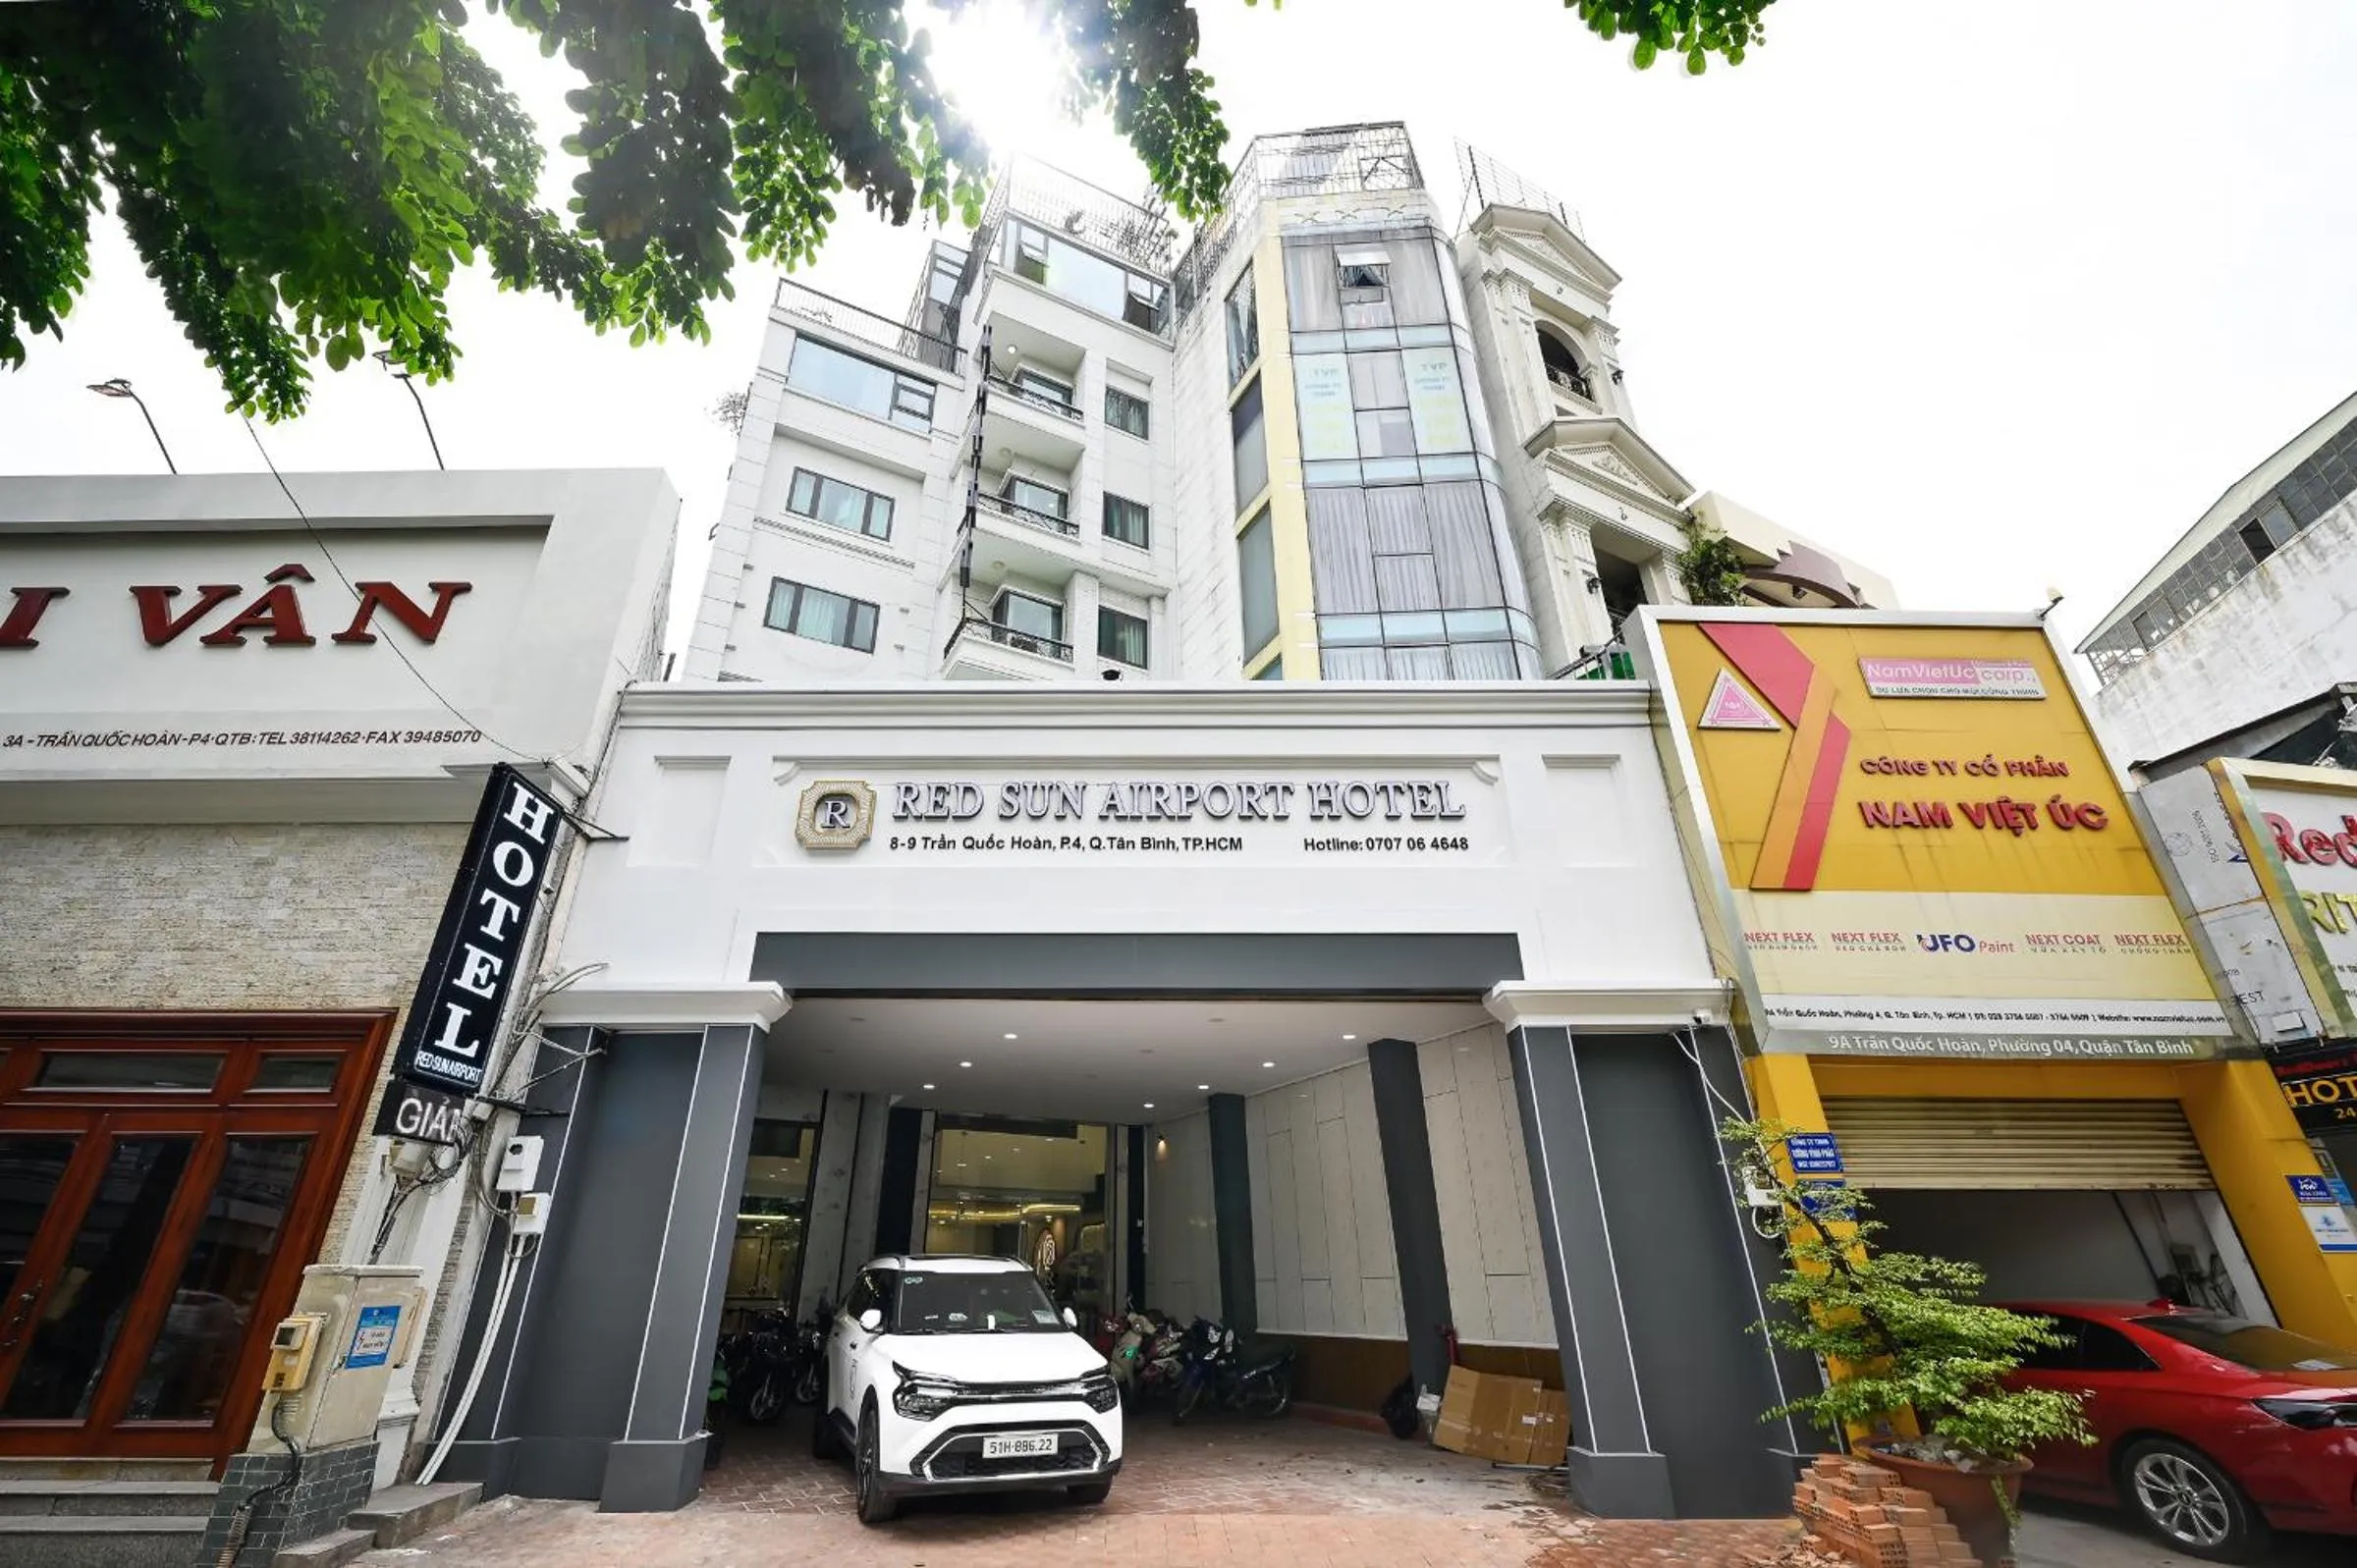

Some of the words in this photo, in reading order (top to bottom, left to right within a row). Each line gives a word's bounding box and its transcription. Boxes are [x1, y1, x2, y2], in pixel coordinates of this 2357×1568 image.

[129, 564, 473, 647] VÂN
[3, 734, 24, 747] 3A
[403, 730, 481, 744] 39485070
[1860, 756, 1930, 777] CÔNG
[1933, 759, 1958, 777] TY
[1964, 754, 2001, 777] CỔ
[892, 782, 984, 819] RED
[997, 781, 1086, 820] SUN
[1098, 781, 1295, 821] AIRPORT
[1307, 781, 1466, 822] HOTEL
[821, 800, 850, 829] R
[1858, 800, 1954, 830] NAM
[1957, 795, 2039, 838] VIỆT
[2046, 793, 2110, 831] ÚC
[890, 836, 917, 850] 8-9
[921, 834, 957, 850] Trần
[962, 834, 1006, 851] Quốc
[1011, 835, 1057, 852] Hoàn,
[1304, 837, 1363, 851] Hotline:
[1365, 837, 1401, 851] 0707
[1407, 837, 1425, 851] 06
[1430, 837, 1469, 851] 4648
[433, 781, 555, 1059] HOTEL
[1744, 932, 1779, 943] NEXT
[1782, 932, 1815, 943] FLEX
[1832, 932, 1866, 943] NEXT
[1869, 933, 1901, 944] FLEX
[1917, 934, 1976, 952] UFO
[1979, 940, 2014, 954] Paint
[2026, 934, 2060, 946] NEXT
[2062, 934, 2101, 946] COAT
[2114, 934, 2150, 946] NEXT
[2152, 934, 2187, 946] FLEX
[1829, 1036, 1852, 1050] 9A
[2123, 1039, 2155, 1054] Tân
